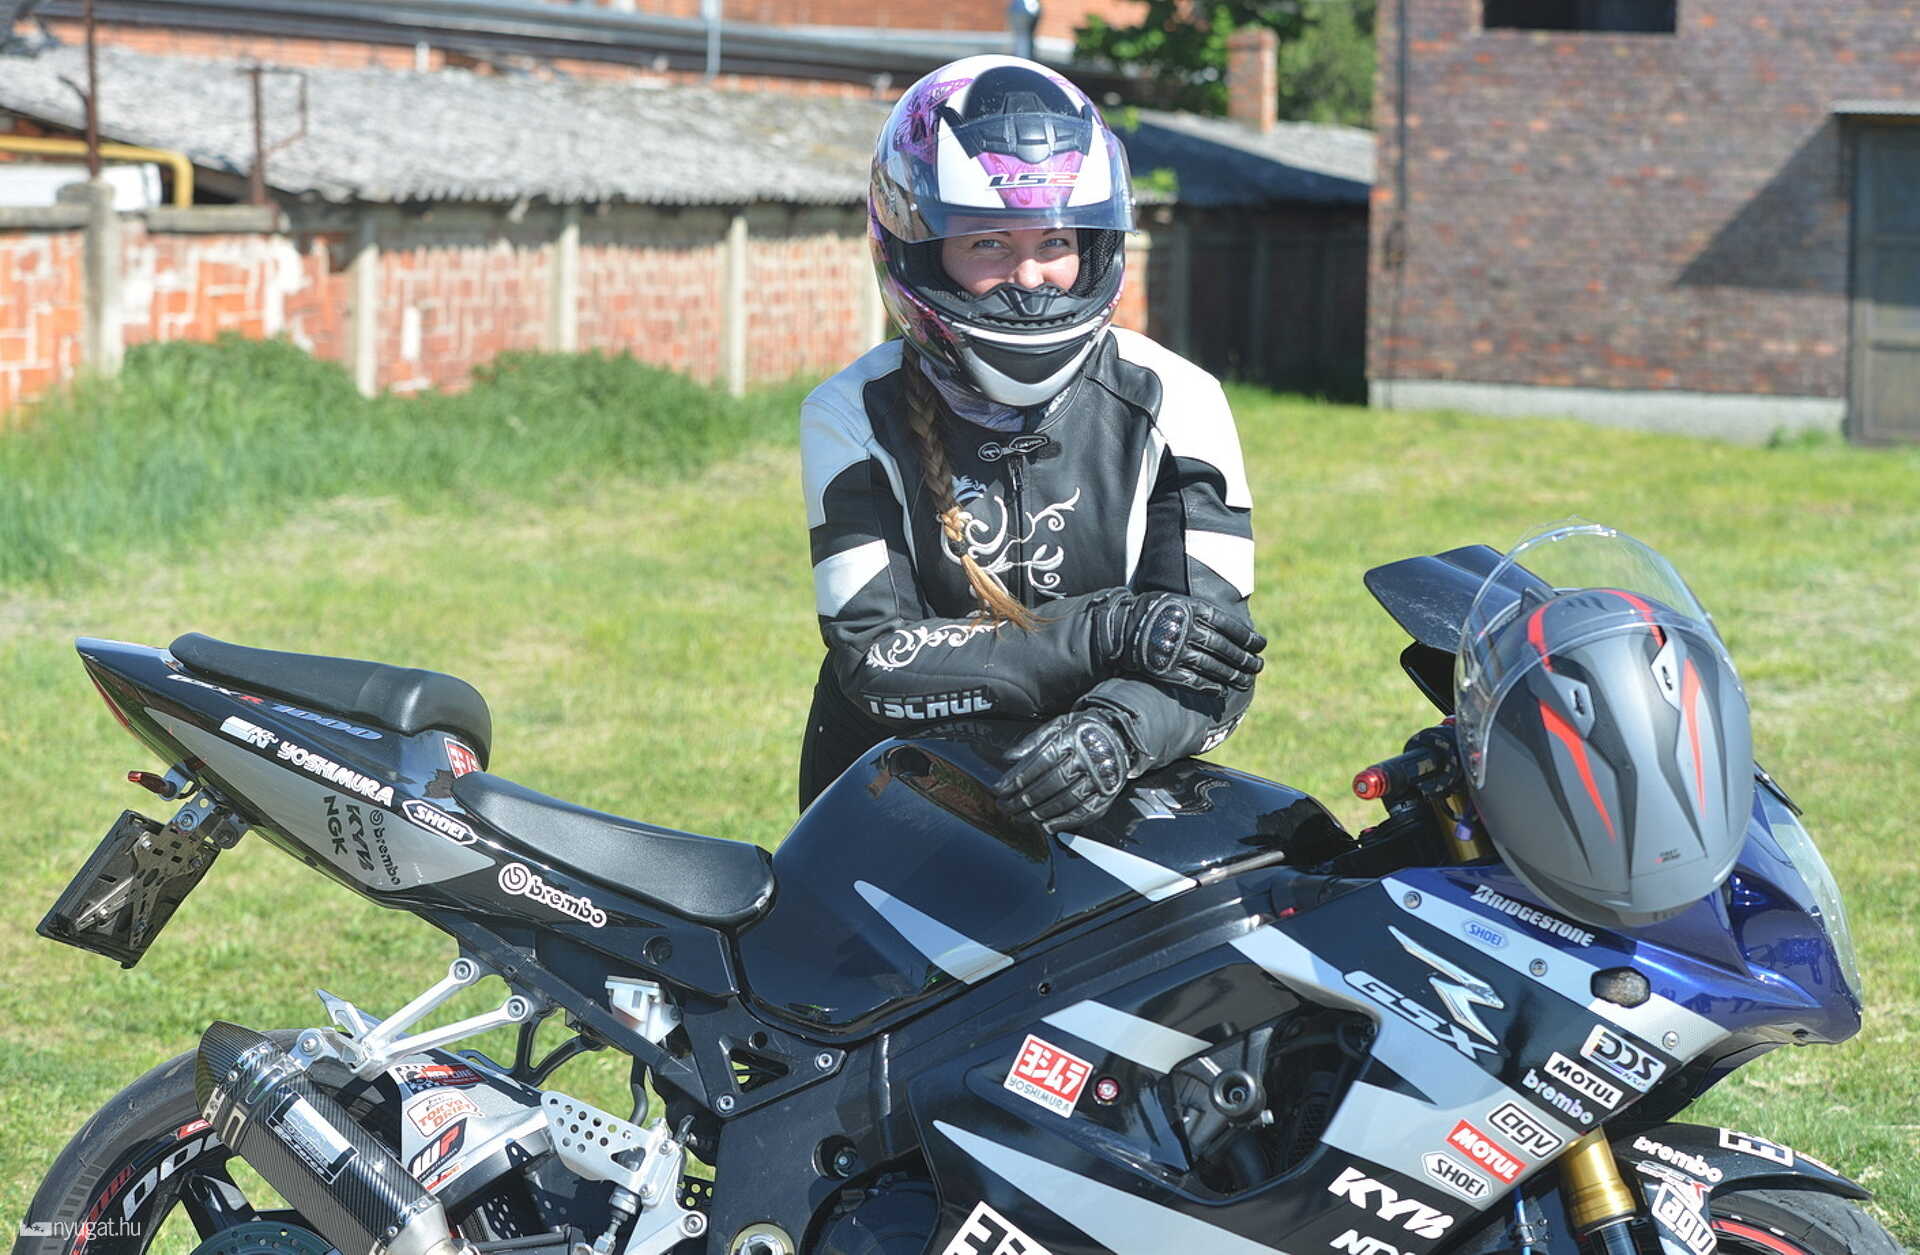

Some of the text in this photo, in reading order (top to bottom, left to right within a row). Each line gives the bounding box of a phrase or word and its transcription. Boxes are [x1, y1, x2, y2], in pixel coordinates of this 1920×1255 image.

[987, 172, 1079, 188] LS2
[271, 704, 383, 740] 1000
[277, 740, 395, 807] YOSHIMURA
[323, 795, 348, 855] NGK
[346, 804, 375, 871] KYB
[413, 806, 468, 840] SHOEI
[373, 827, 400, 886] brembo
[529, 876, 606, 927] brembo
[1471, 884, 1596, 948] BRIDGESTONE
[1468, 923, 1504, 946] SHOEI
[1343, 970, 1499, 1060] GSX
[1017, 1042, 1086, 1094] ヨシムラ
[1552, 1061, 1615, 1104] MOTUL
[1008, 1076, 1070, 1113] YOSHIMURA
[1522, 1068, 1594, 1125] brembo
[1452, 1128, 1520, 1179] MOTUL
[1500, 1112, 1553, 1149] agv
[1432, 1158, 1484, 1197] SHOEI
[1632, 1136, 1724, 1183] brembo
[1327, 1166, 1454, 1239] KYB
